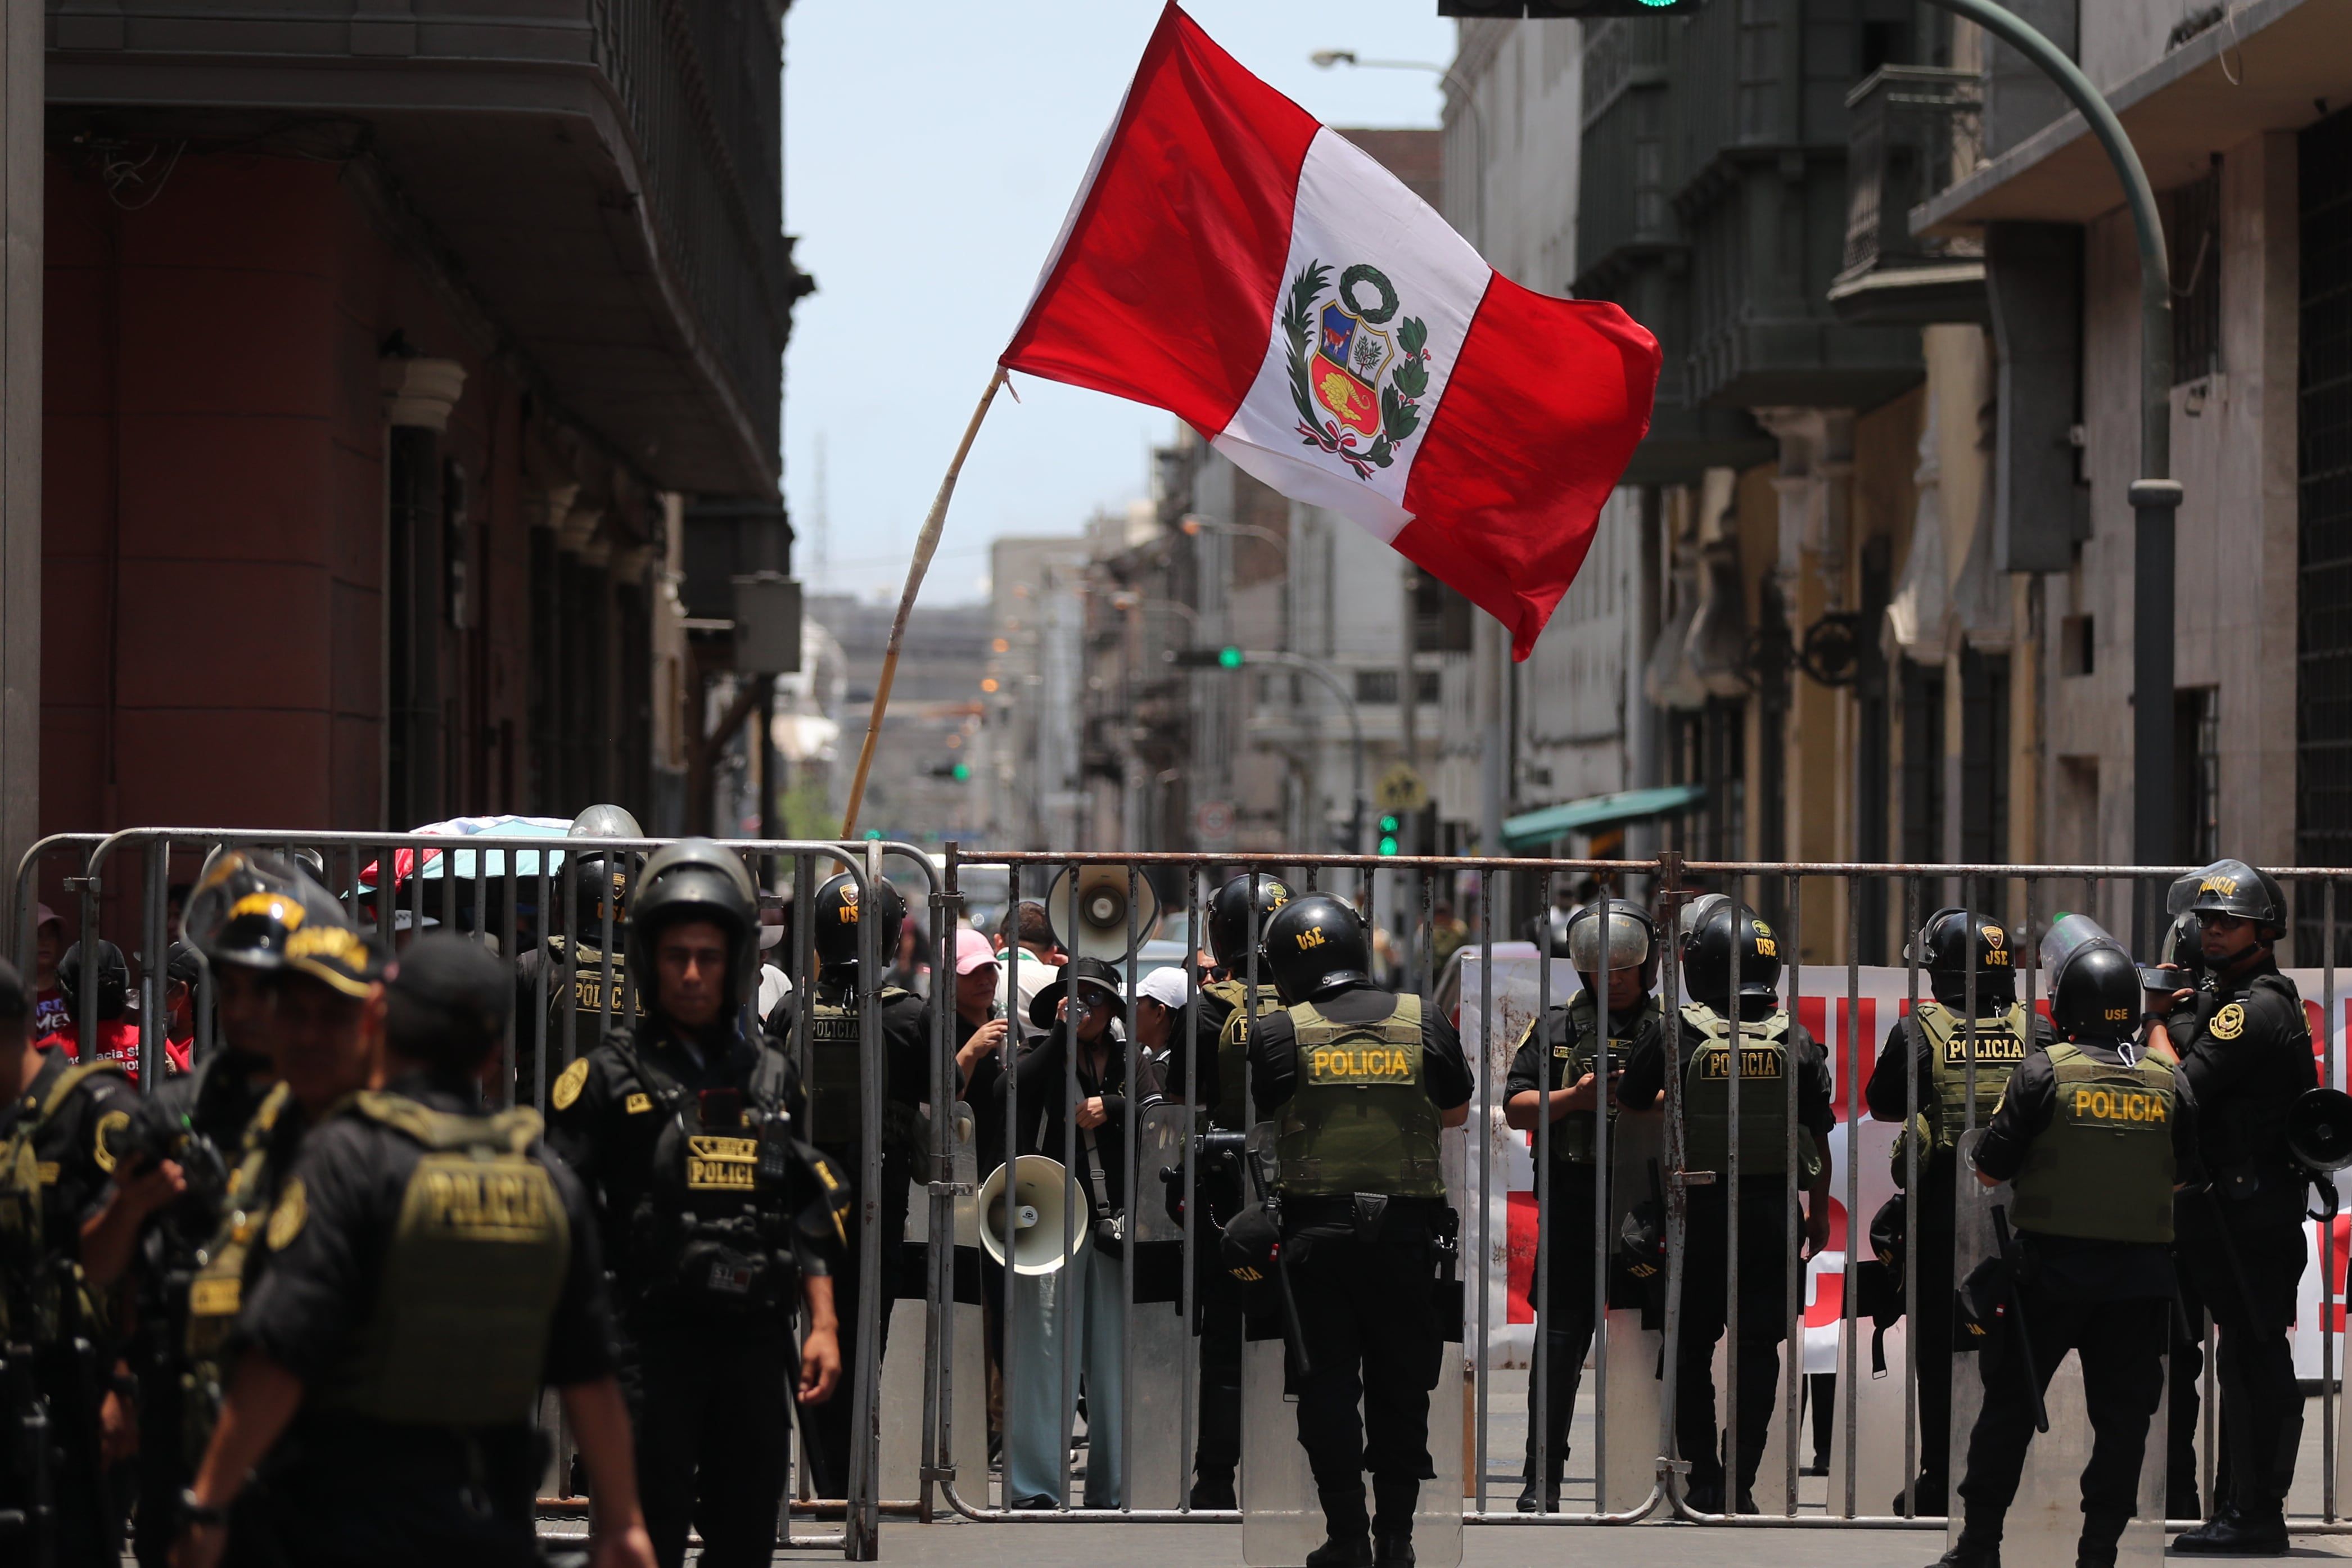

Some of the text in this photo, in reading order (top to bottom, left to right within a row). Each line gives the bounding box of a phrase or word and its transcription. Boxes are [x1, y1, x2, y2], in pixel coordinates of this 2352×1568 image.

[839, 906, 859, 923] US
[1296, 926, 1325, 950] USE
[1755, 937, 1776, 956] USE
[2105, 1009, 2128, 1020] USE
[1313, 1049, 1409, 1076] POLICIA
[1709, 1051, 1776, 1077] POICIA
[2075, 1090, 2166, 1122] POLICIA
[692, 1162, 754, 1185] POLICI
